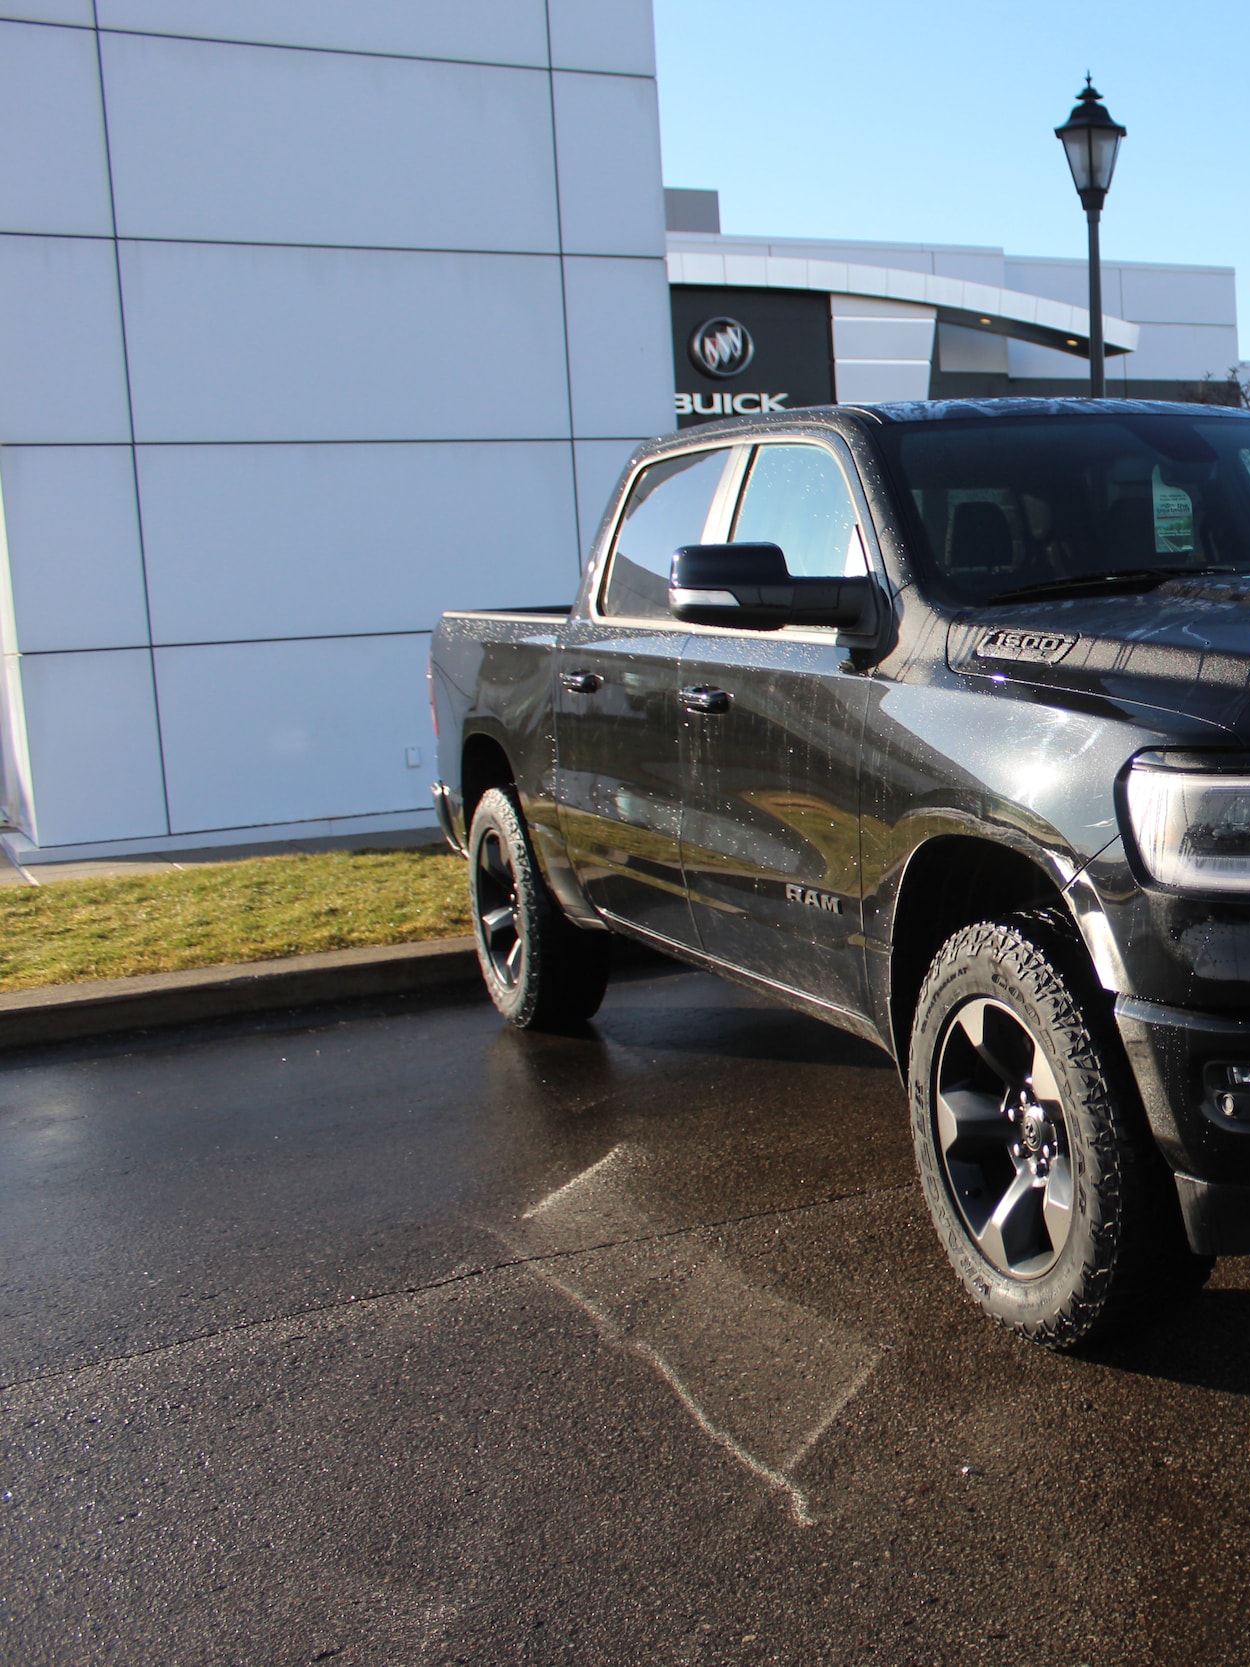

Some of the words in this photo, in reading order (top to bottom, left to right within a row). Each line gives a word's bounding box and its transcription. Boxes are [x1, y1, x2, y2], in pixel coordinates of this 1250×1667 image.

[674, 392, 789, 415] BUICK
[996, 632, 1060, 651] 1500
[786, 883, 843, 915] RAM
